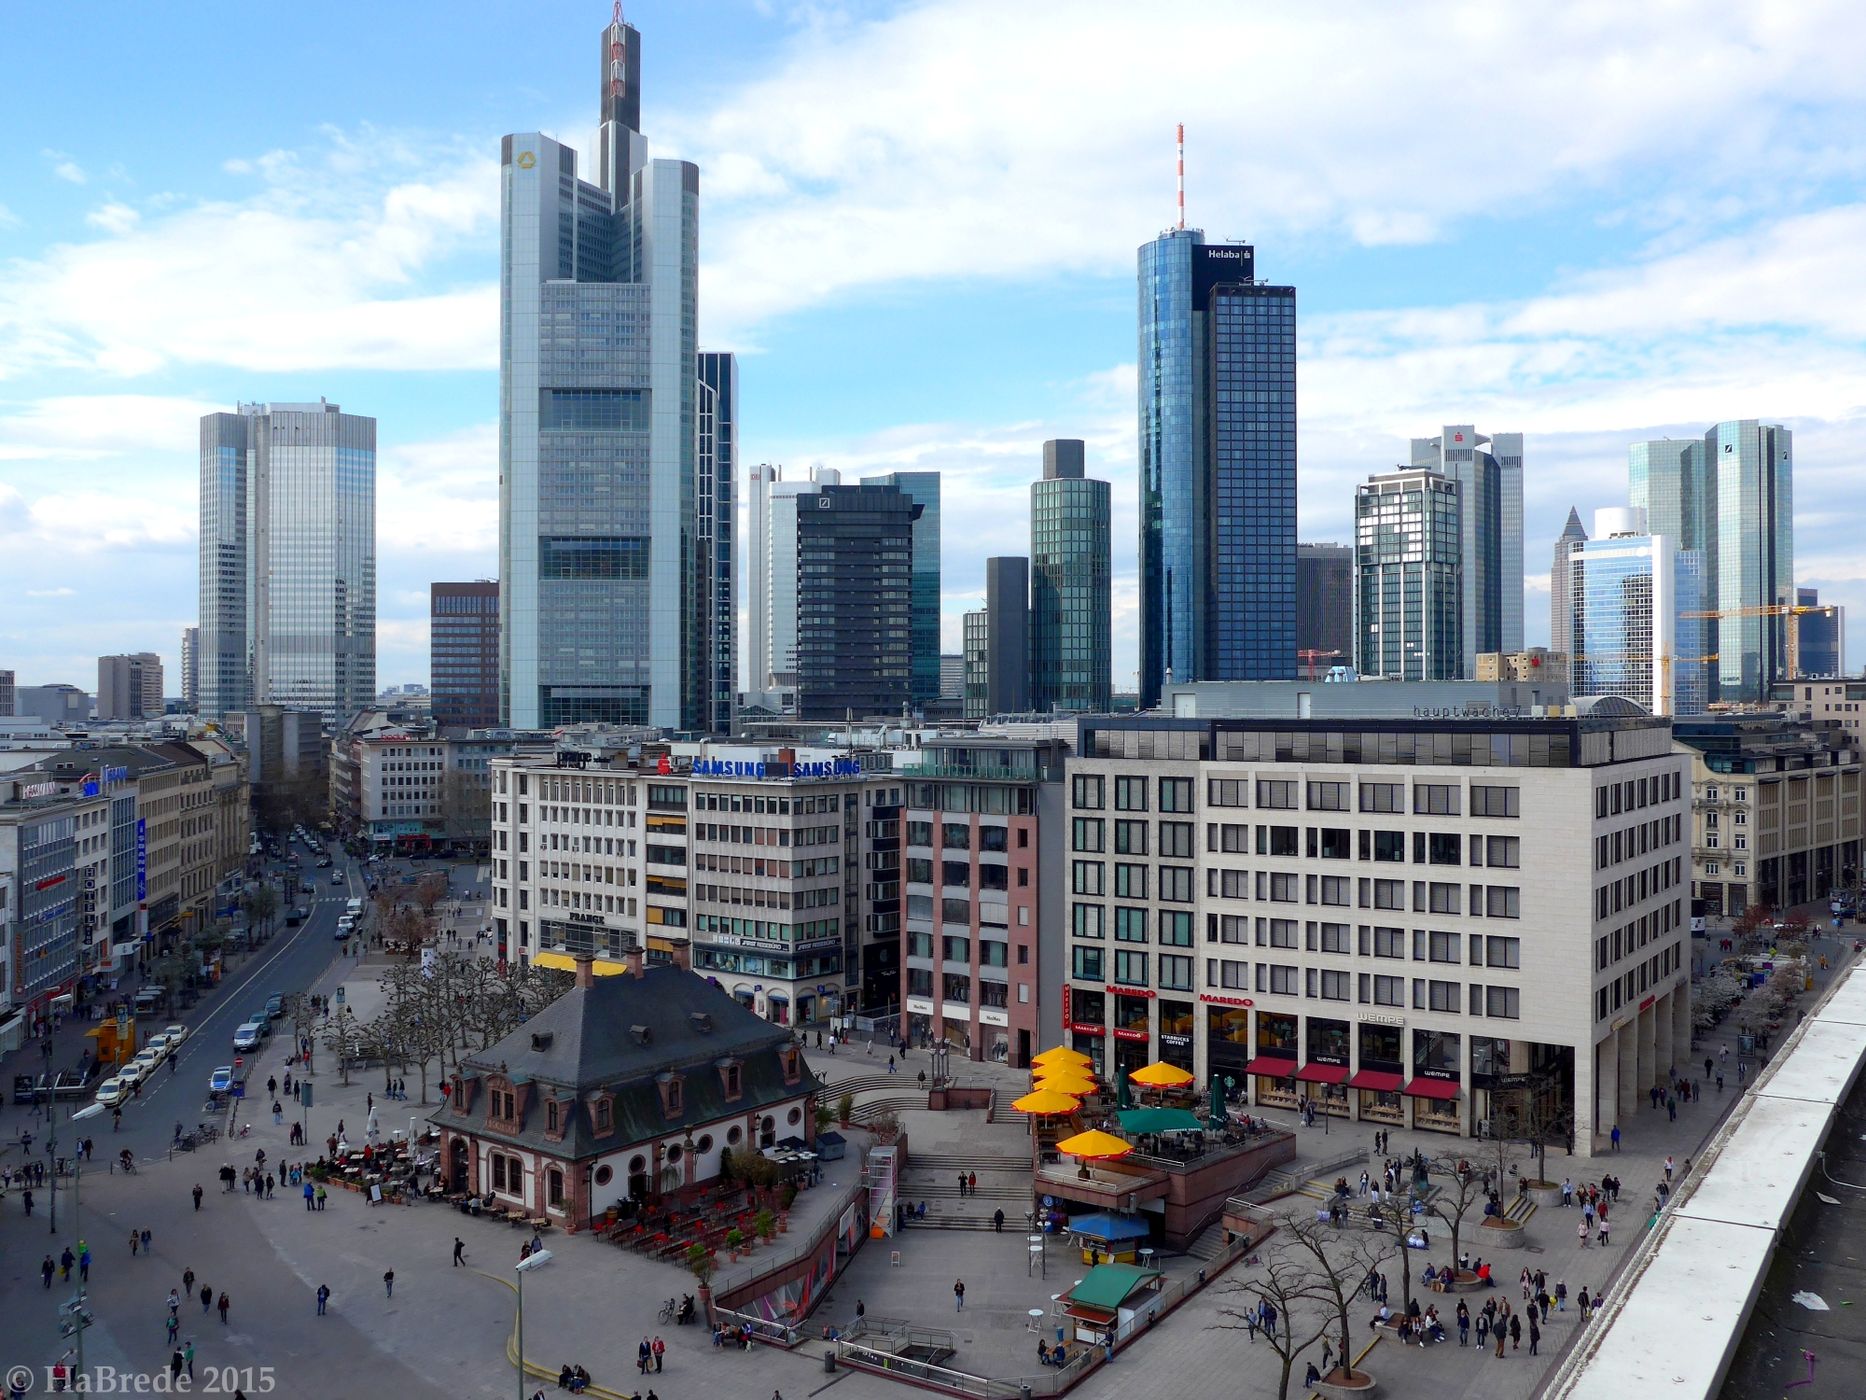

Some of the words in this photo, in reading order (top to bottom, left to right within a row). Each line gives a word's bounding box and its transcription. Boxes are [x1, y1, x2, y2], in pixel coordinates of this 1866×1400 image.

[1208, 249, 1240, 259] Helaba
[692, 757, 765, 777] SAMSUNG
[793, 757, 861, 777] SAMSUNG
[85, 868, 95, 923] HOTEL
[569, 912, 605, 925] PRANGE
[1106, 985, 1156, 999] MAREDO
[1200, 994, 1254, 1007] MAREDO
[1356, 1012, 1404, 1025] WEMPE
[1075, 1025, 1098, 1033] MAREDO
[1118, 1031, 1141, 1039] MAREDO
[1161, 1034, 1190, 1043] STARBUCKS
[1316, 1056, 1341, 1064] WEMPE
[1424, 1070, 1450, 1078] WEMPE
